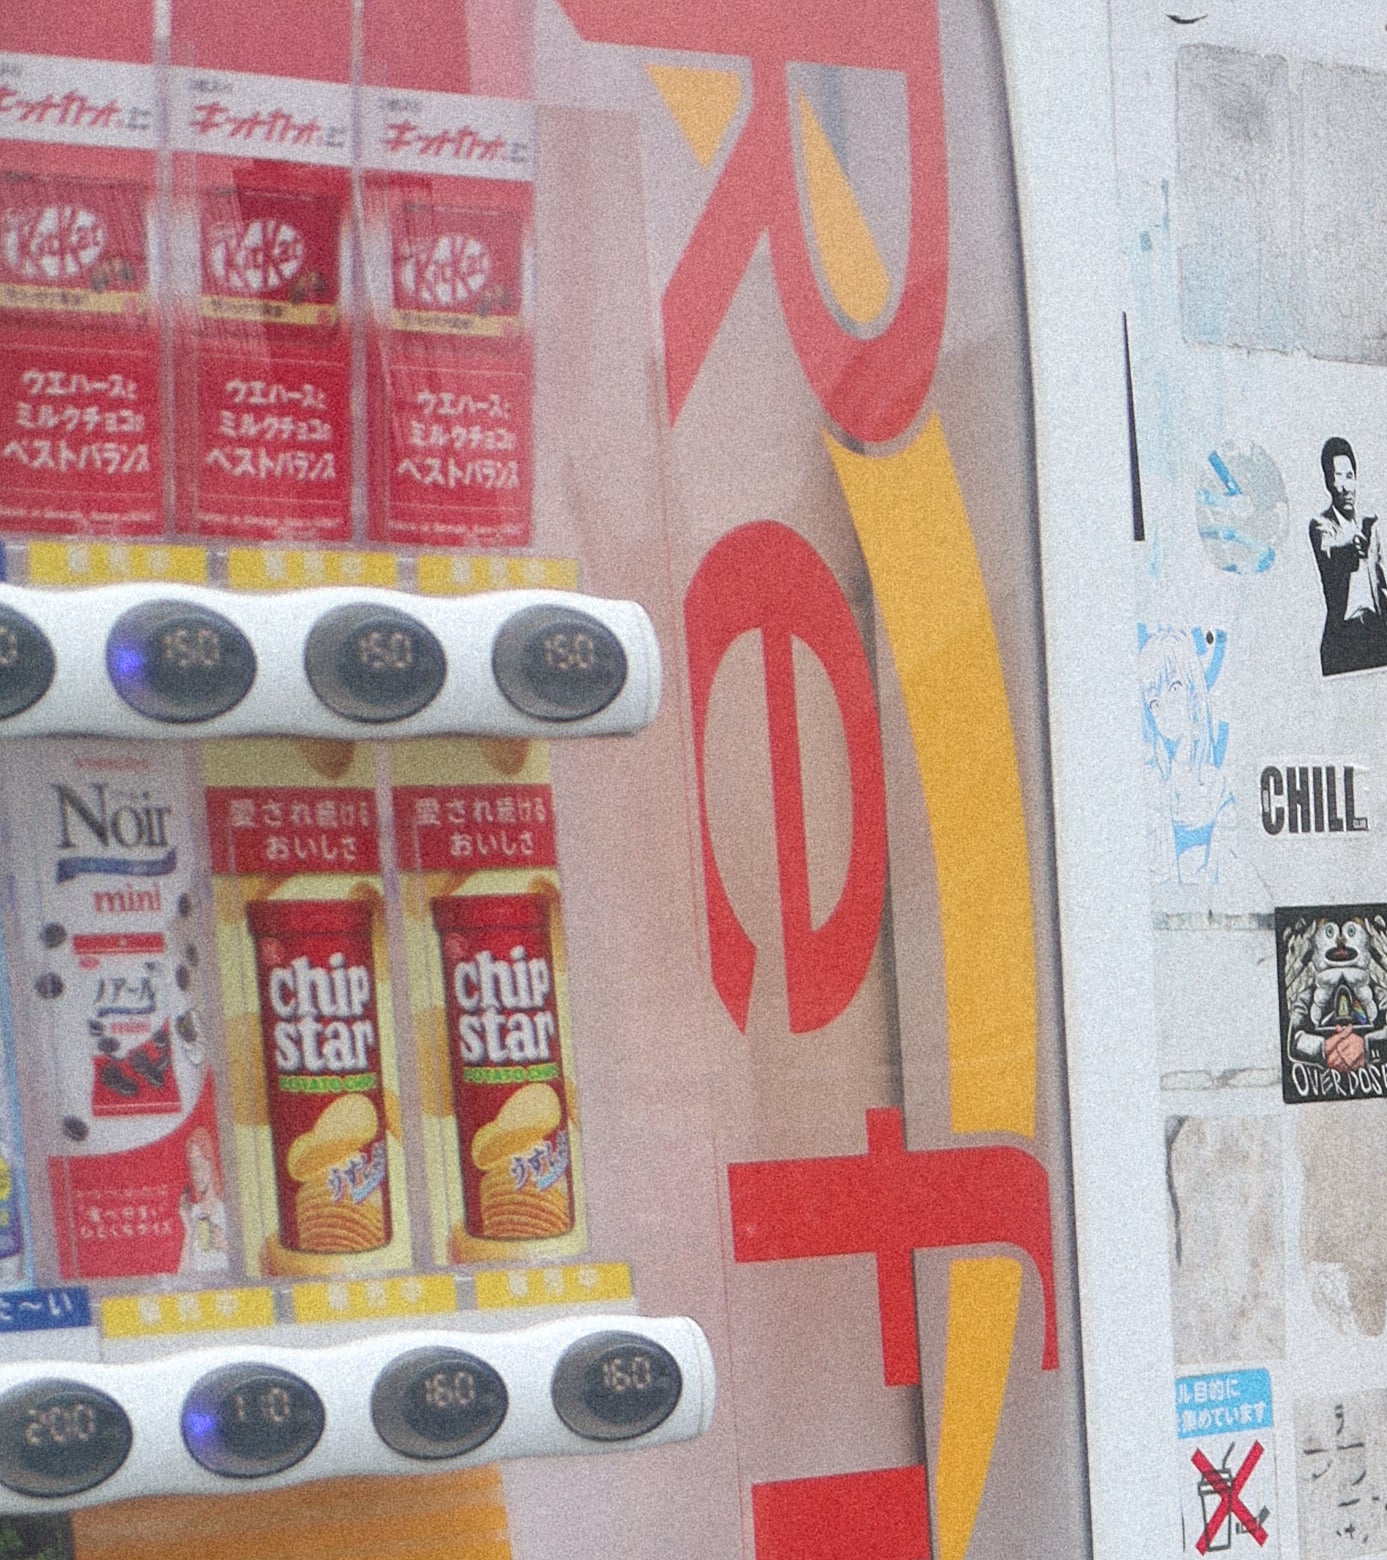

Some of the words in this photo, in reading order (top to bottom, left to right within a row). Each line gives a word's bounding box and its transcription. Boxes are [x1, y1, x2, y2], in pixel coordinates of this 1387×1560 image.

[51, 782, 172, 850] Noir
[1259, 765, 1368, 835] CHILL
[265, 833, 358, 862] おいしさ
[450, 829, 535, 858] おいしさ
[93, 882, 162, 914] mini
[268, 952, 369, 1018] chip
[453, 945, 550, 1012] chip
[273, 1015, 376, 1074] star
[457, 1005, 557, 1064] star
